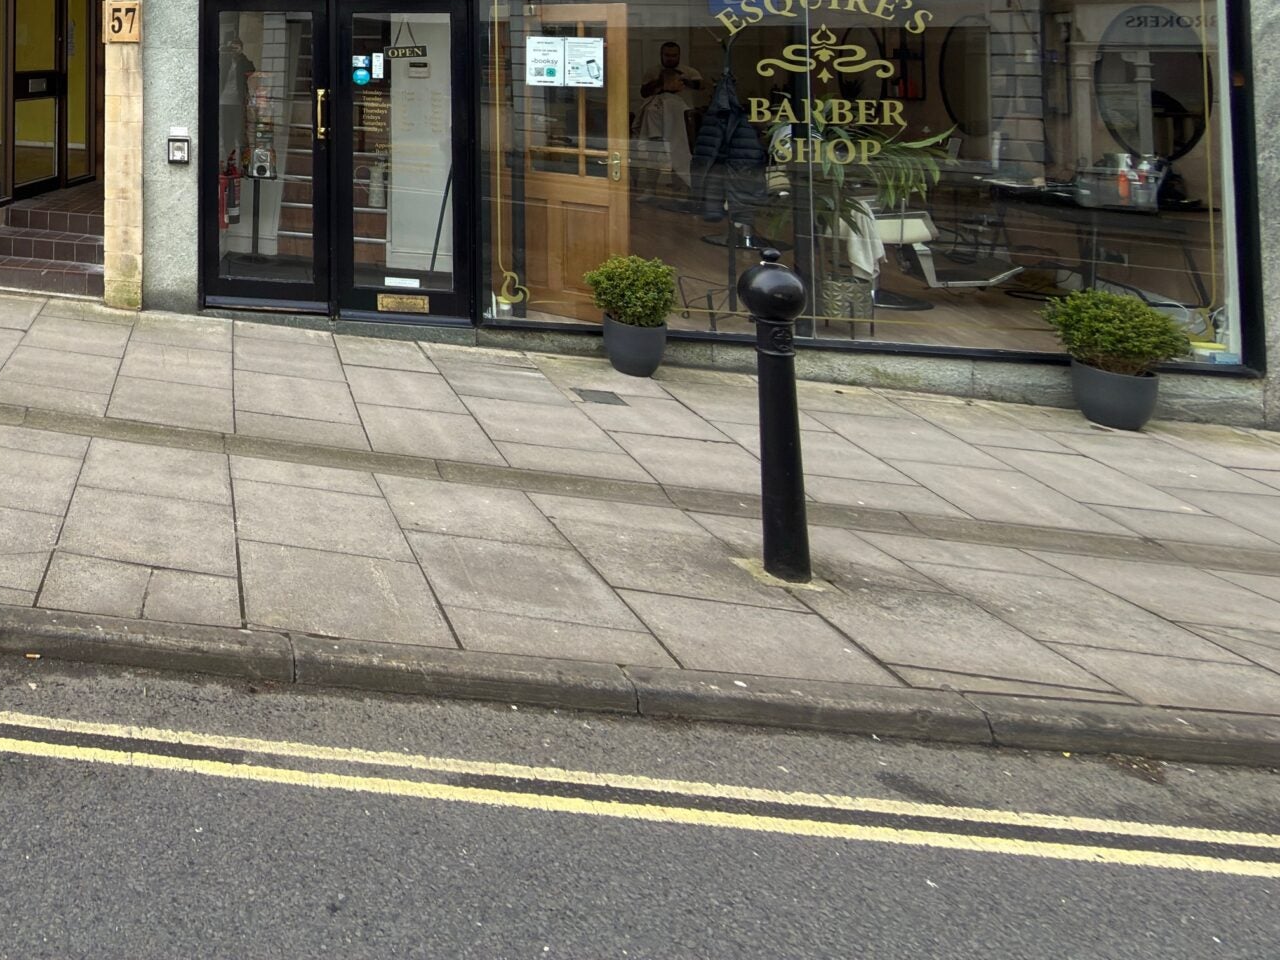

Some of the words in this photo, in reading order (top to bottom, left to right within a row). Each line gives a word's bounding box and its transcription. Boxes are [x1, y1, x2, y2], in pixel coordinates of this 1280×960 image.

[111, 7, 136, 34] 57
[388, 47, 422, 57] OPEN
[747, 97, 907, 125] BARBER
[774, 138, 881, 165] SHOP
